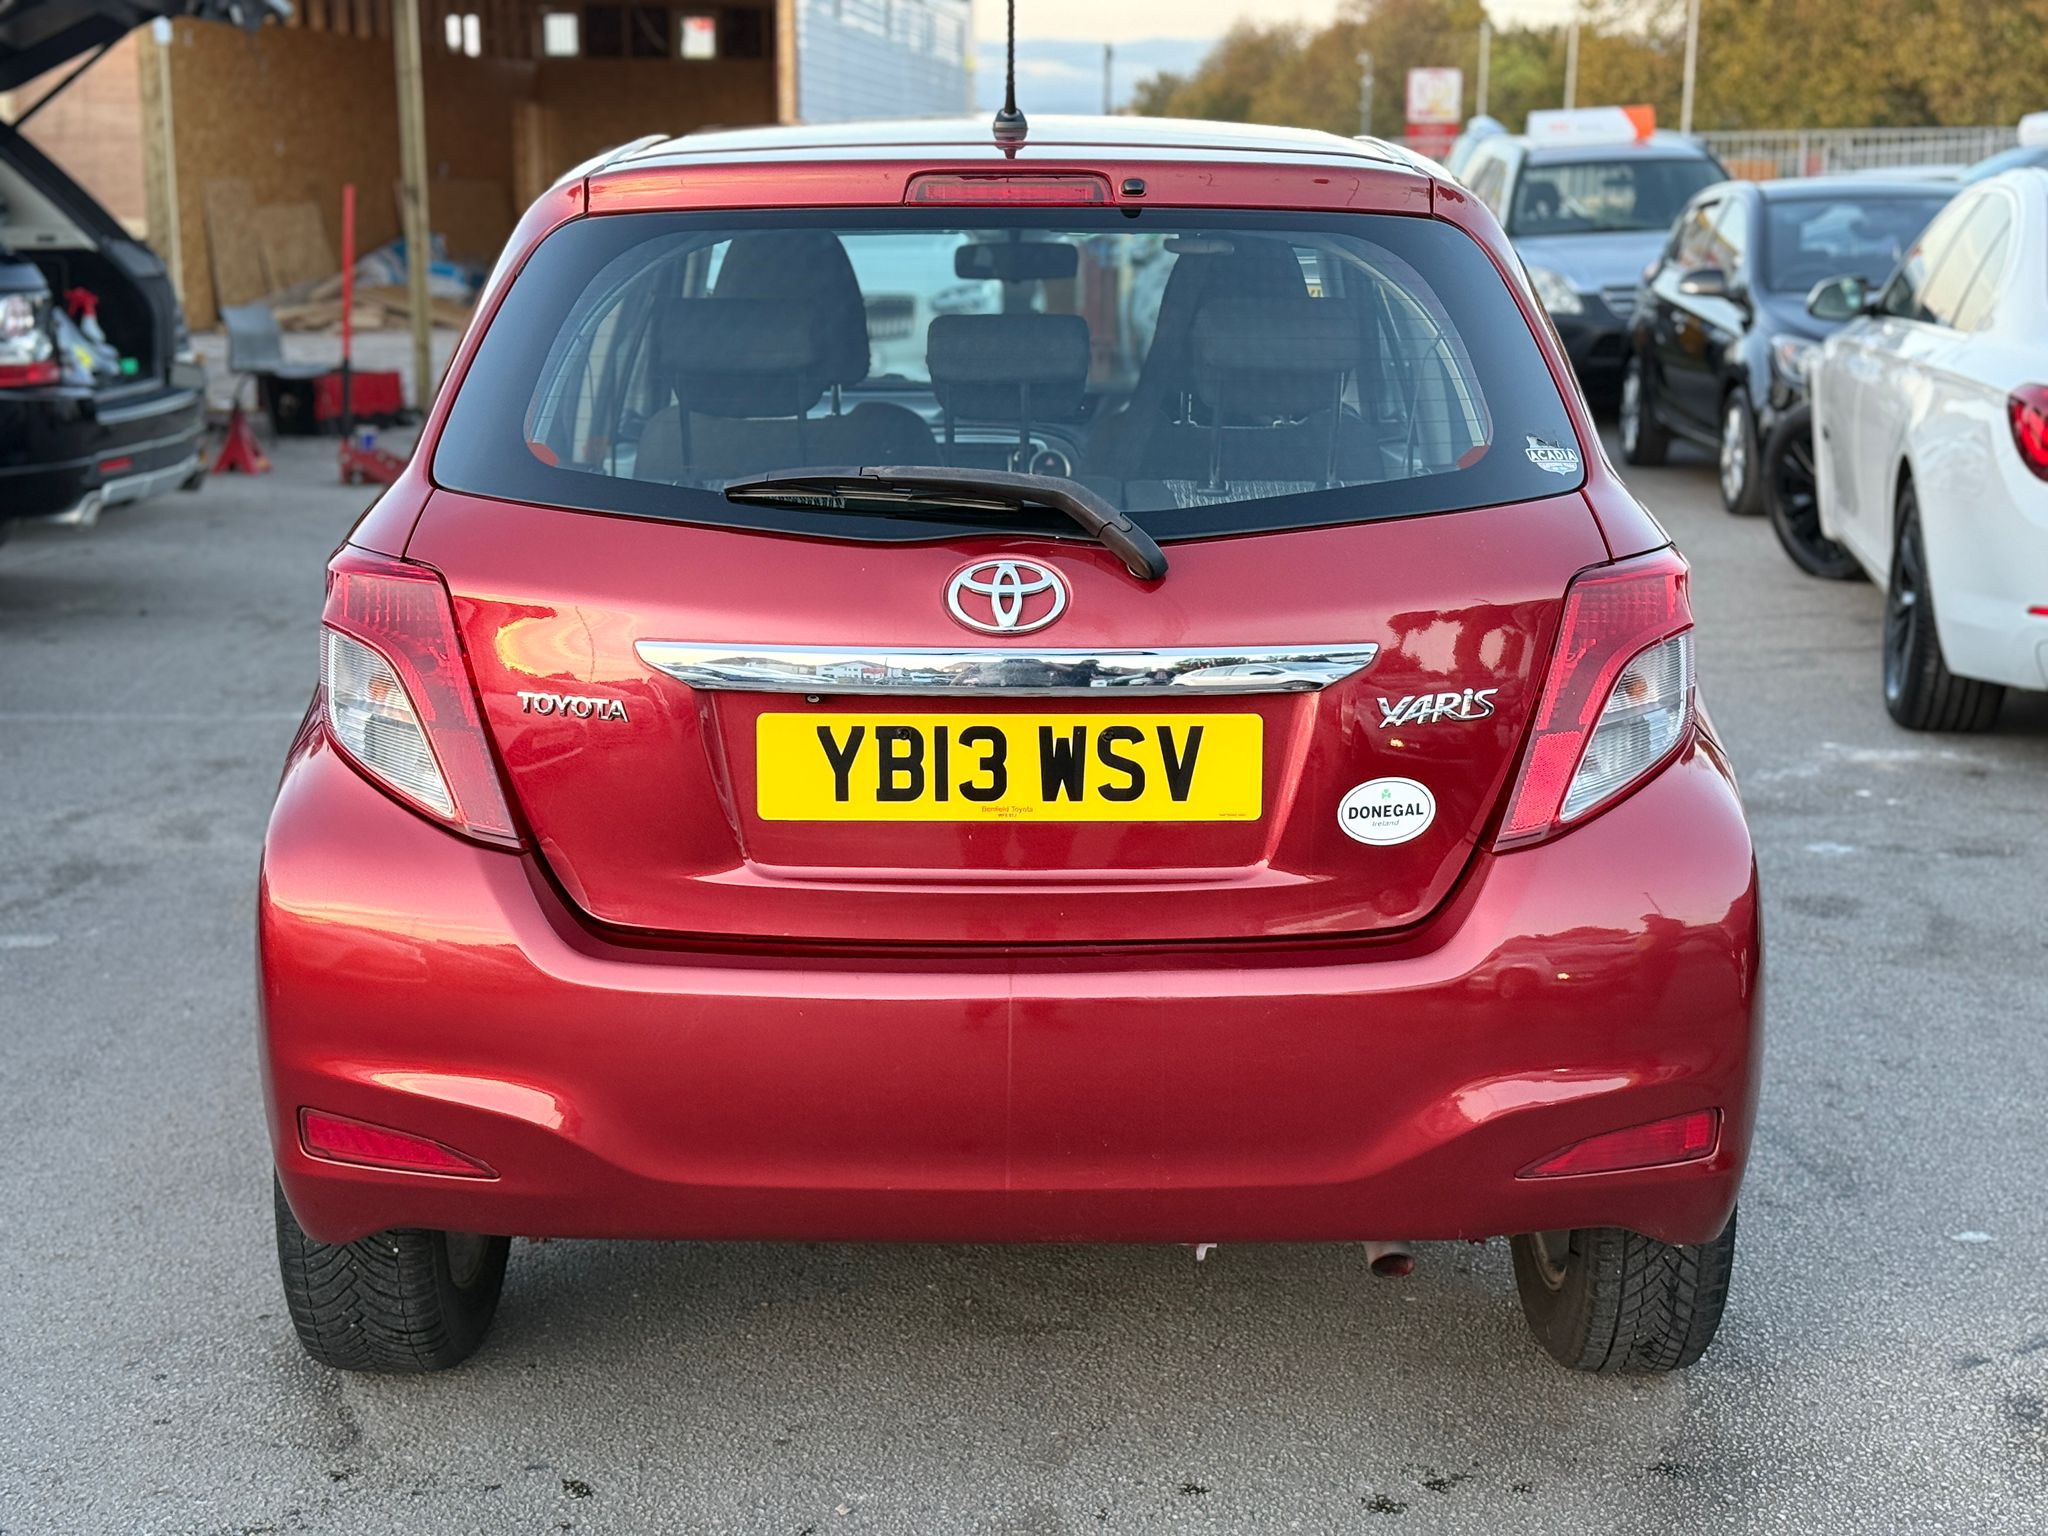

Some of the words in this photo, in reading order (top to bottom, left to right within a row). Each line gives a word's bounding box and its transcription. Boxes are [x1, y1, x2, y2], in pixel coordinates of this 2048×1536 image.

[1529, 449, 1576, 461] ACADIA
[517, 690, 630, 722] TOYOTA
[816, 725, 1008, 802] YB13
[1038, 725, 1205, 802] WSV
[1012, 805, 1034, 814] Toyota
[1348, 803, 1424, 820] DONEGAL
[1372, 819, 1400, 827] Ireland
